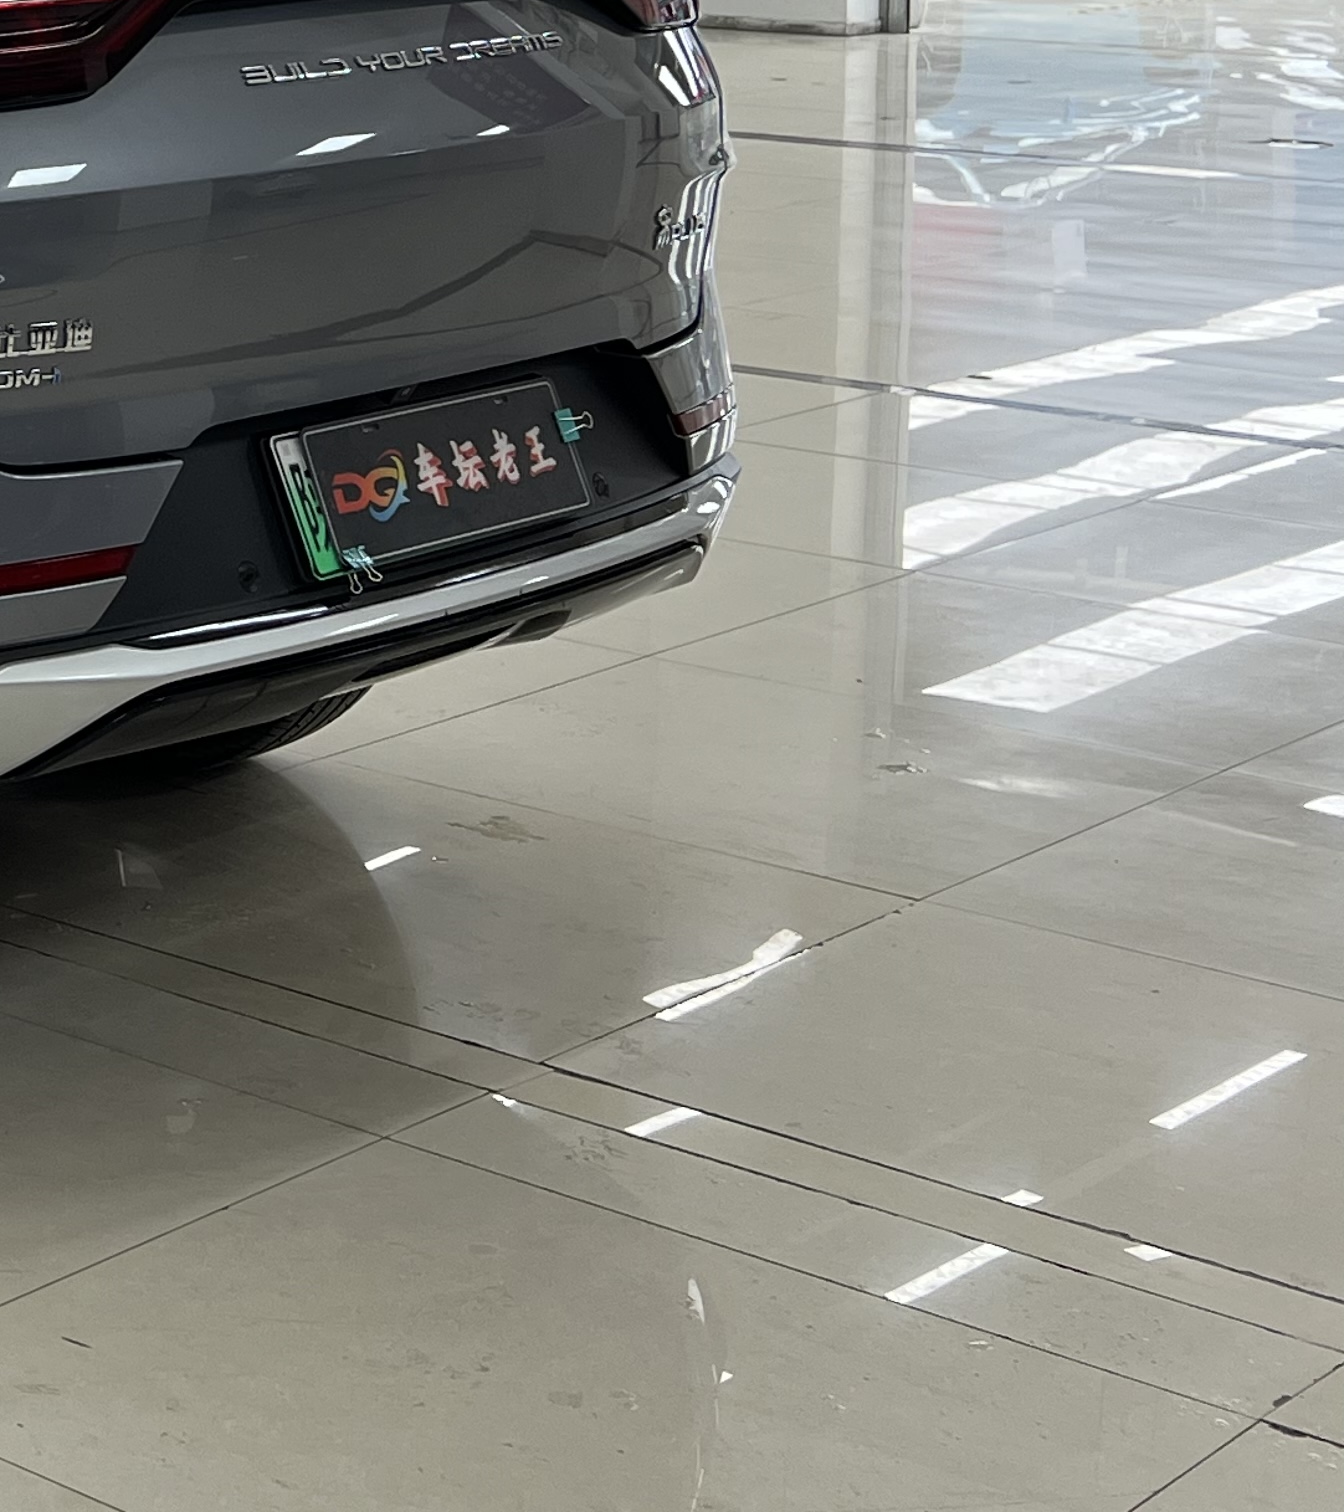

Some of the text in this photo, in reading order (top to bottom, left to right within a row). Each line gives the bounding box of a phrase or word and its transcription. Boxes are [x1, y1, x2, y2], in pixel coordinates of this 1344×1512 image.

[240, 30, 564, 86] BUILD YOUR DREAMS
[413, 424, 557, 507] 车坛老王
